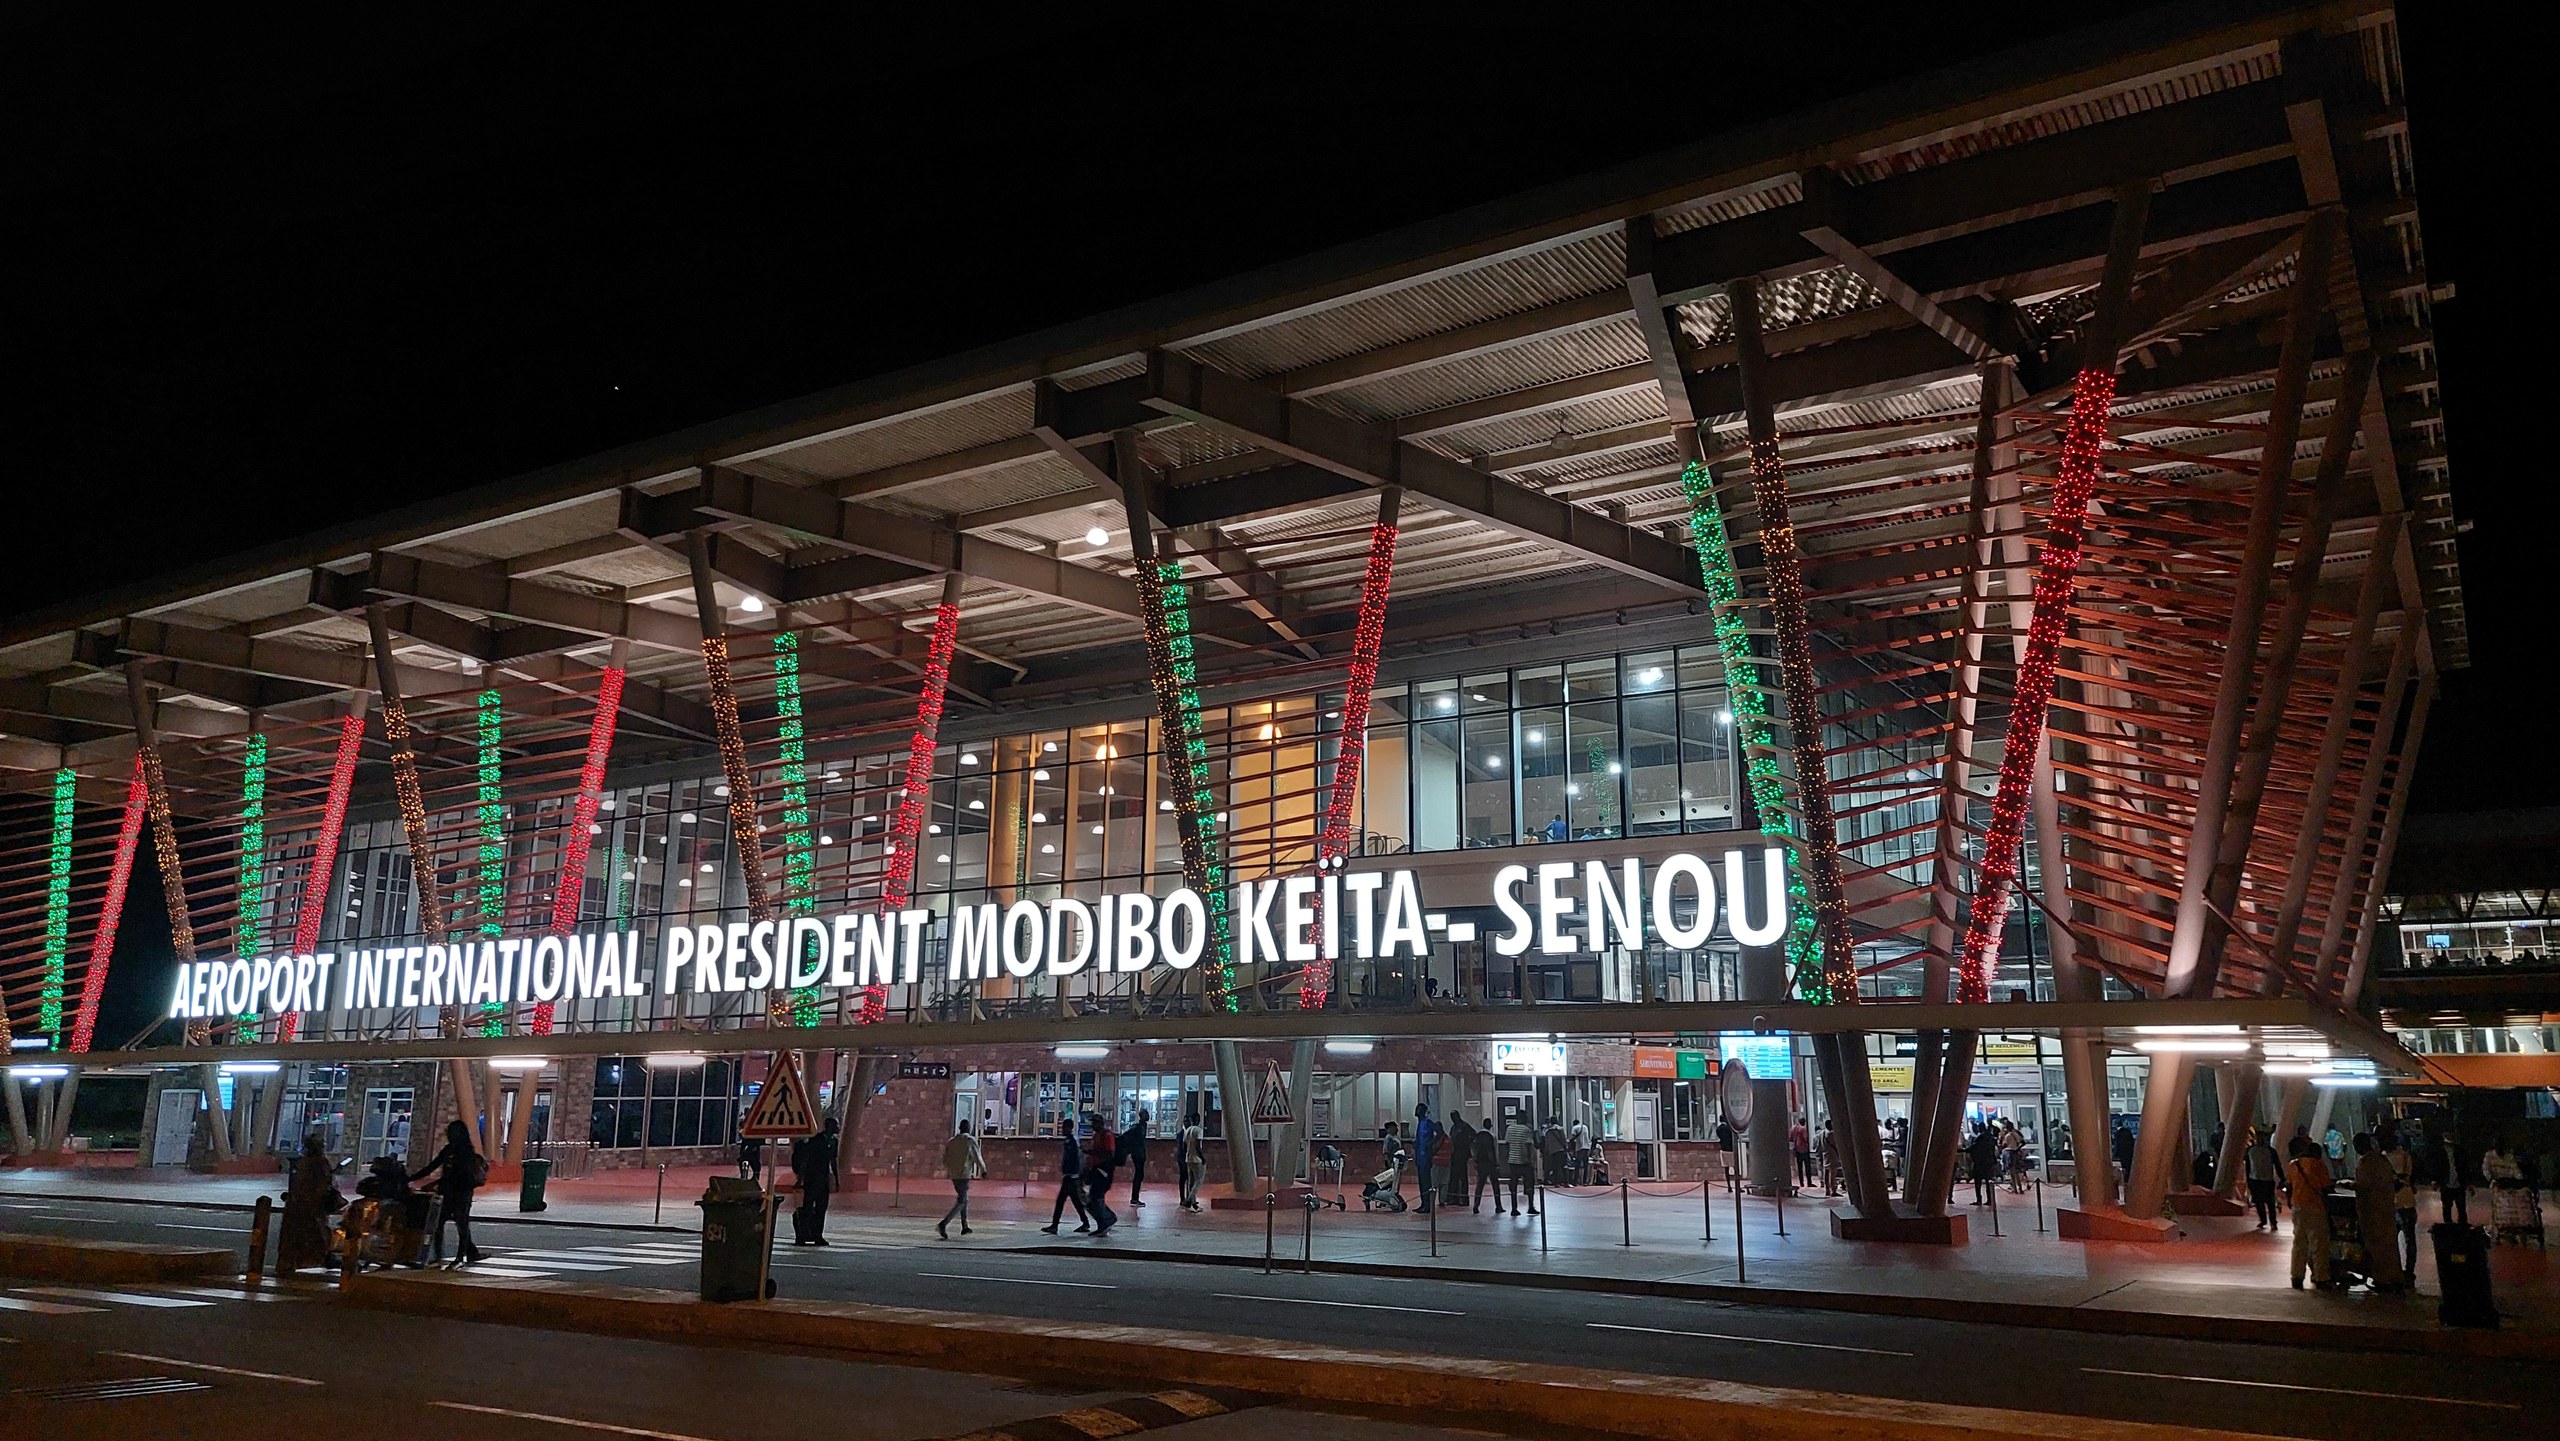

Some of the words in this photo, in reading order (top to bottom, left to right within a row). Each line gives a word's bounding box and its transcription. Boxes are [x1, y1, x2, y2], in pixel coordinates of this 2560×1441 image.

[168, 951, 336, 1019] AEROPORT
[343, 919, 646, 1011] INTERNATIONAL
[664, 909, 930, 997] PRESIDENT
[949, 882, 1206, 981] MODIBO
[1493, 848, 1788, 957] SENOU
